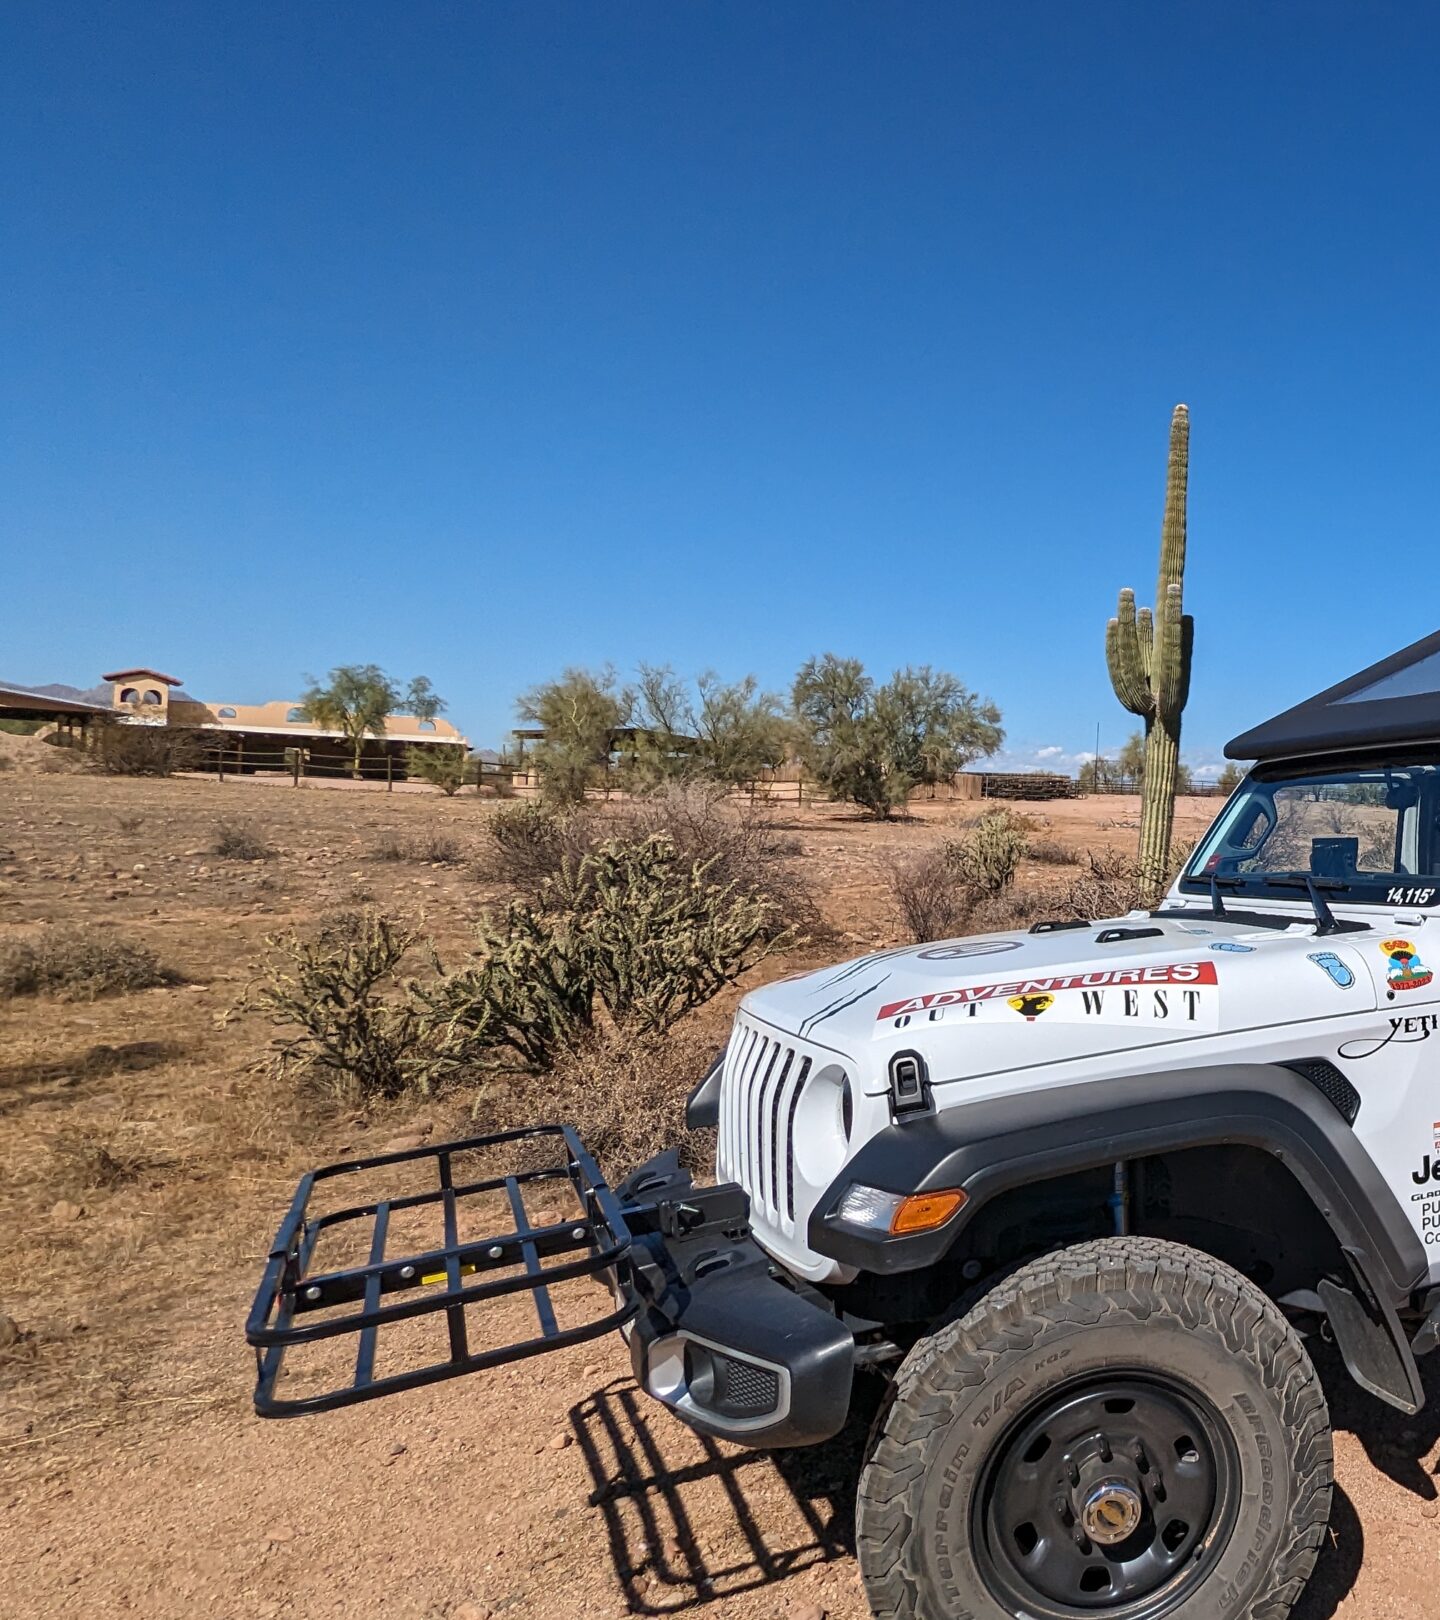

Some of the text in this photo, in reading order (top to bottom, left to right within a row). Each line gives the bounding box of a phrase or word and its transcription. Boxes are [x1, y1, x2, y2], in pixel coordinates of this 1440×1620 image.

[1386, 887, 1436, 905] 14,115'
[892, 963, 1200, 1015] ADVENTURES
[894, 989, 1201, 1028] OUT WEST
